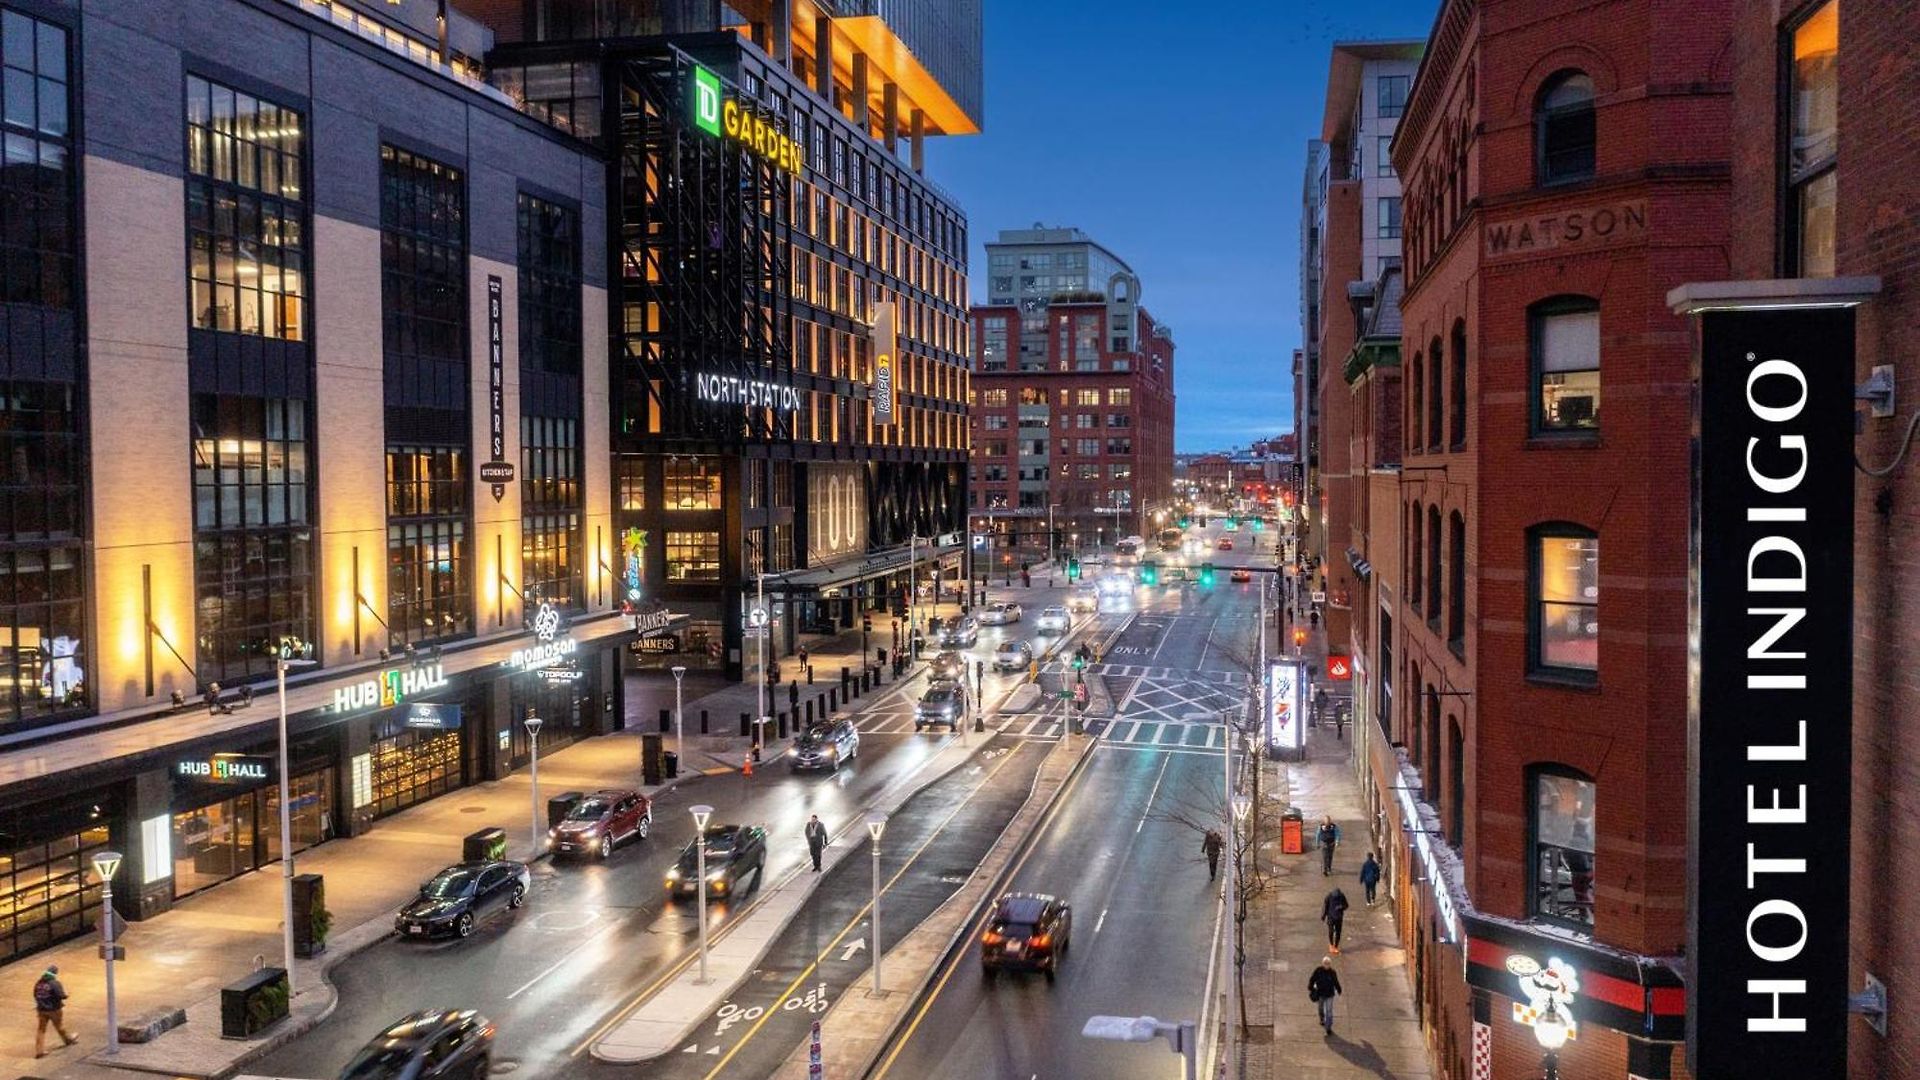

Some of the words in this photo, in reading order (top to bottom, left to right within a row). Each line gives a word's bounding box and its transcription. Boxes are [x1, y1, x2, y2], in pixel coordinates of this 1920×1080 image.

[696, 80, 718, 124] TD
[724, 100, 801, 175] GARDEN
[1487, 203, 1645, 250] WATSON
[492, 298, 501, 456] BANNERS
[698, 372, 748, 404] NORTH
[750, 381, 800, 411] STATION
[974, 535, 984, 549] P
[1747, 360, 1807, 689] INDIGO
[1114, 646, 1152, 655] ONLY
[334, 680, 379, 713] HUB
[402, 664, 449, 696] HALL
[179, 762, 211, 774] HUB
[228, 763, 266, 777] HALL
[1747, 721, 1807, 1032] HOTEL
